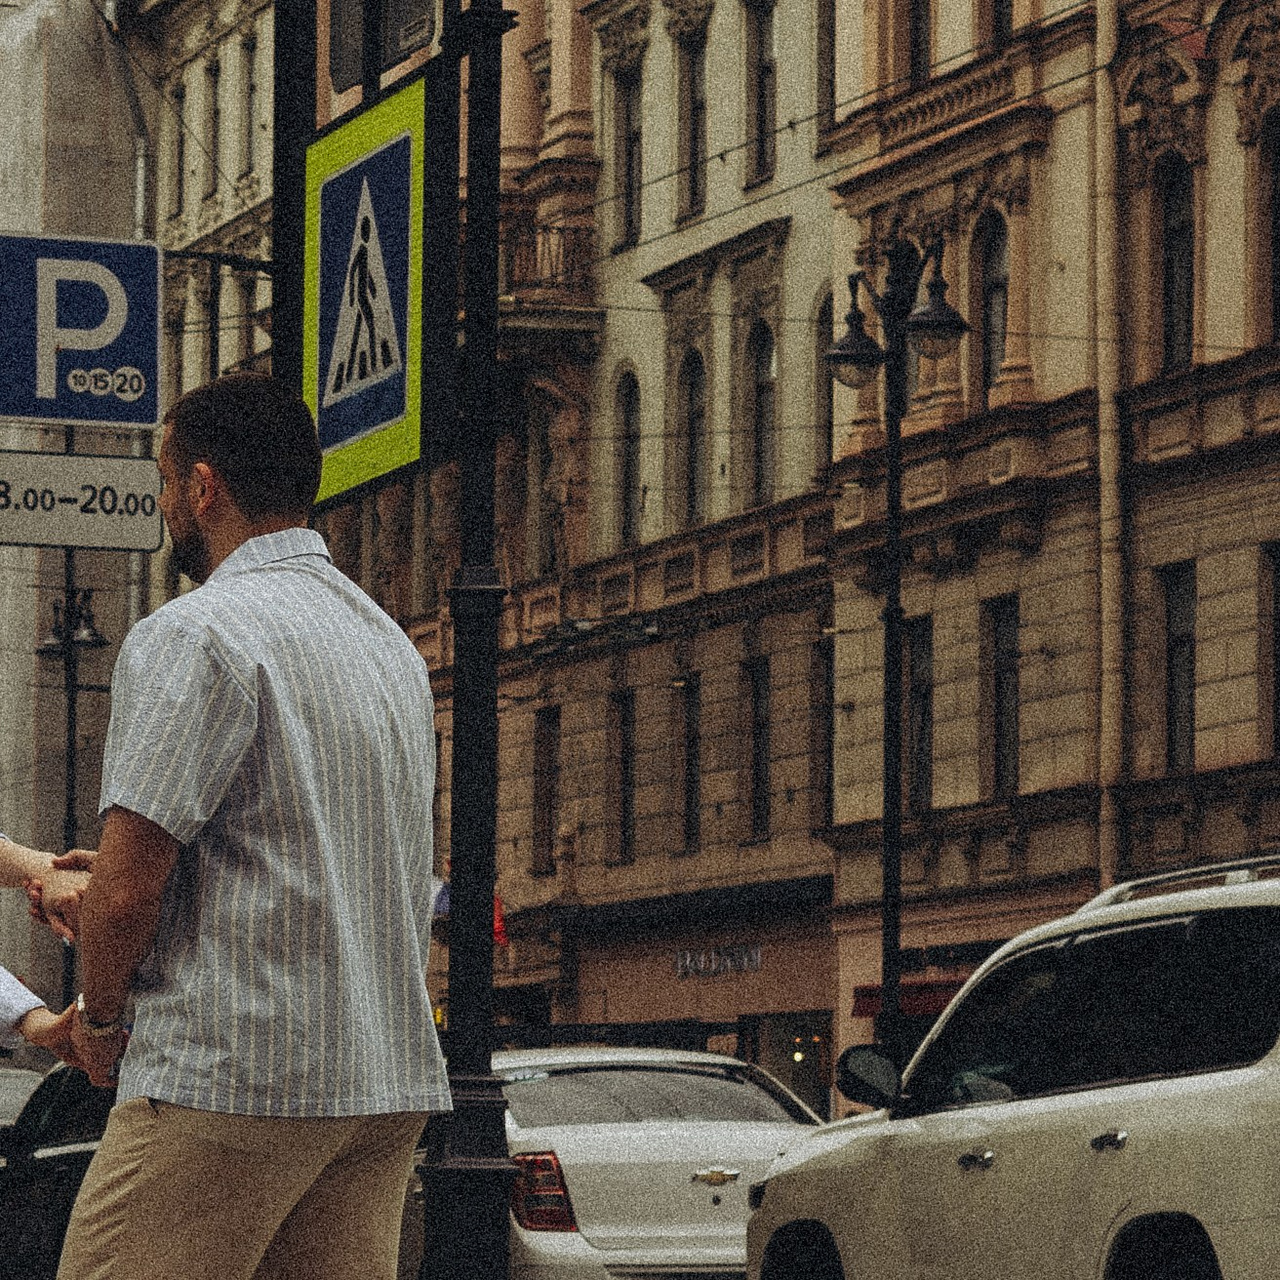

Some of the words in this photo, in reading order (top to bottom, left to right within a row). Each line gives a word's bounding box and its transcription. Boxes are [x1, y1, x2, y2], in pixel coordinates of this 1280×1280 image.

[35, 257, 129, 400] P
[71, 373, 87, 387] 10
[92, 372, 109, 390] 15
[115, 373, 142, 394] 20
